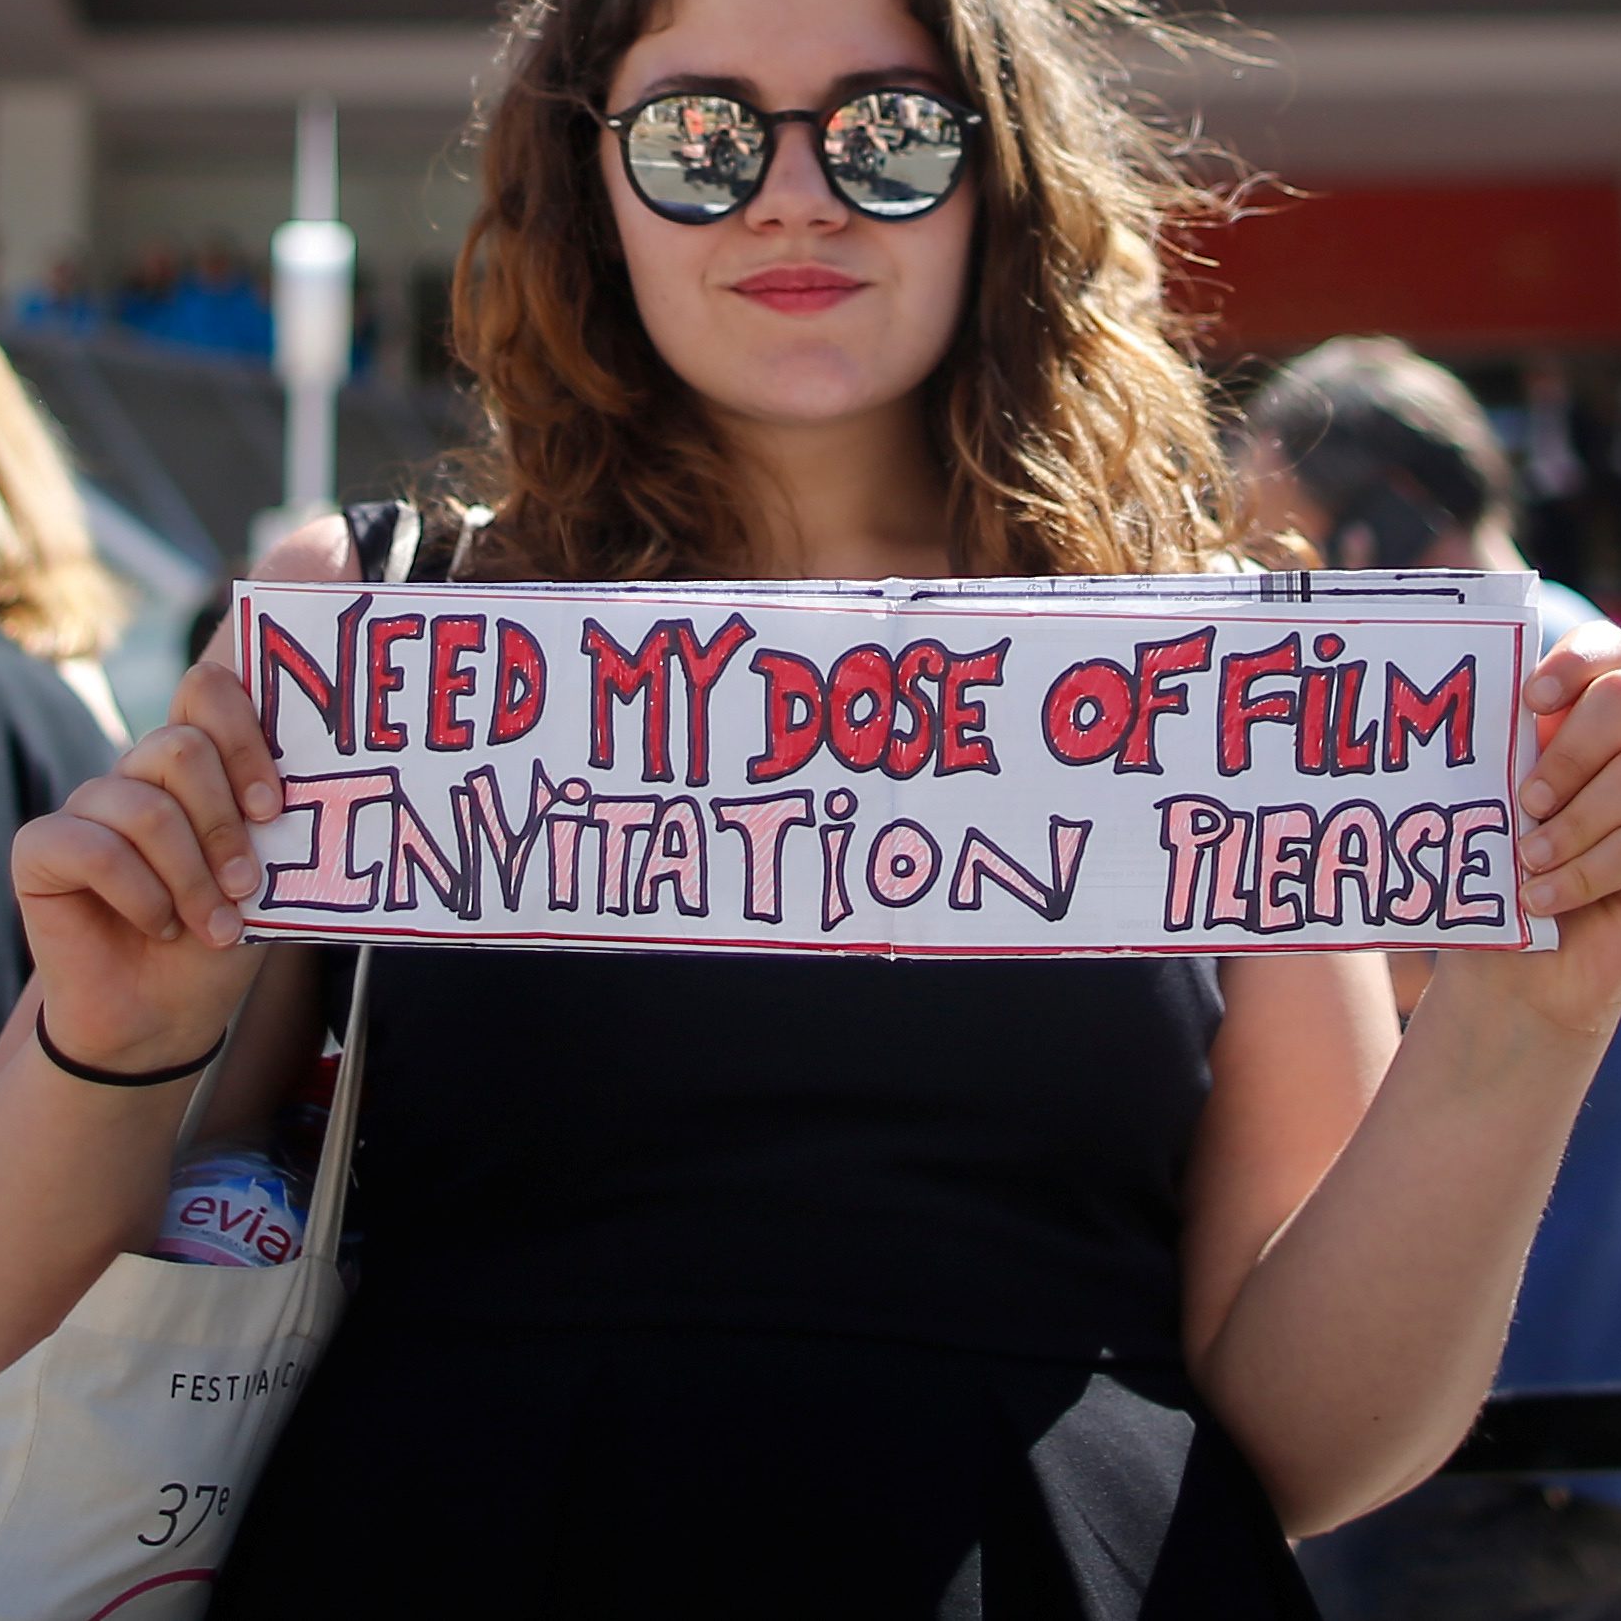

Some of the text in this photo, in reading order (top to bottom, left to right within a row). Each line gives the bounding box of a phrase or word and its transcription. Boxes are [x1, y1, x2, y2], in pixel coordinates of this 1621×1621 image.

[260, 593, 548, 759] NEED
[581, 613, 756, 787] MY
[747, 637, 1012, 783] DOSE
[1041, 626, 1216, 775] OF
[1153, 792, 1510, 935] PLEASE
[179, 1194, 303, 1266] evia
